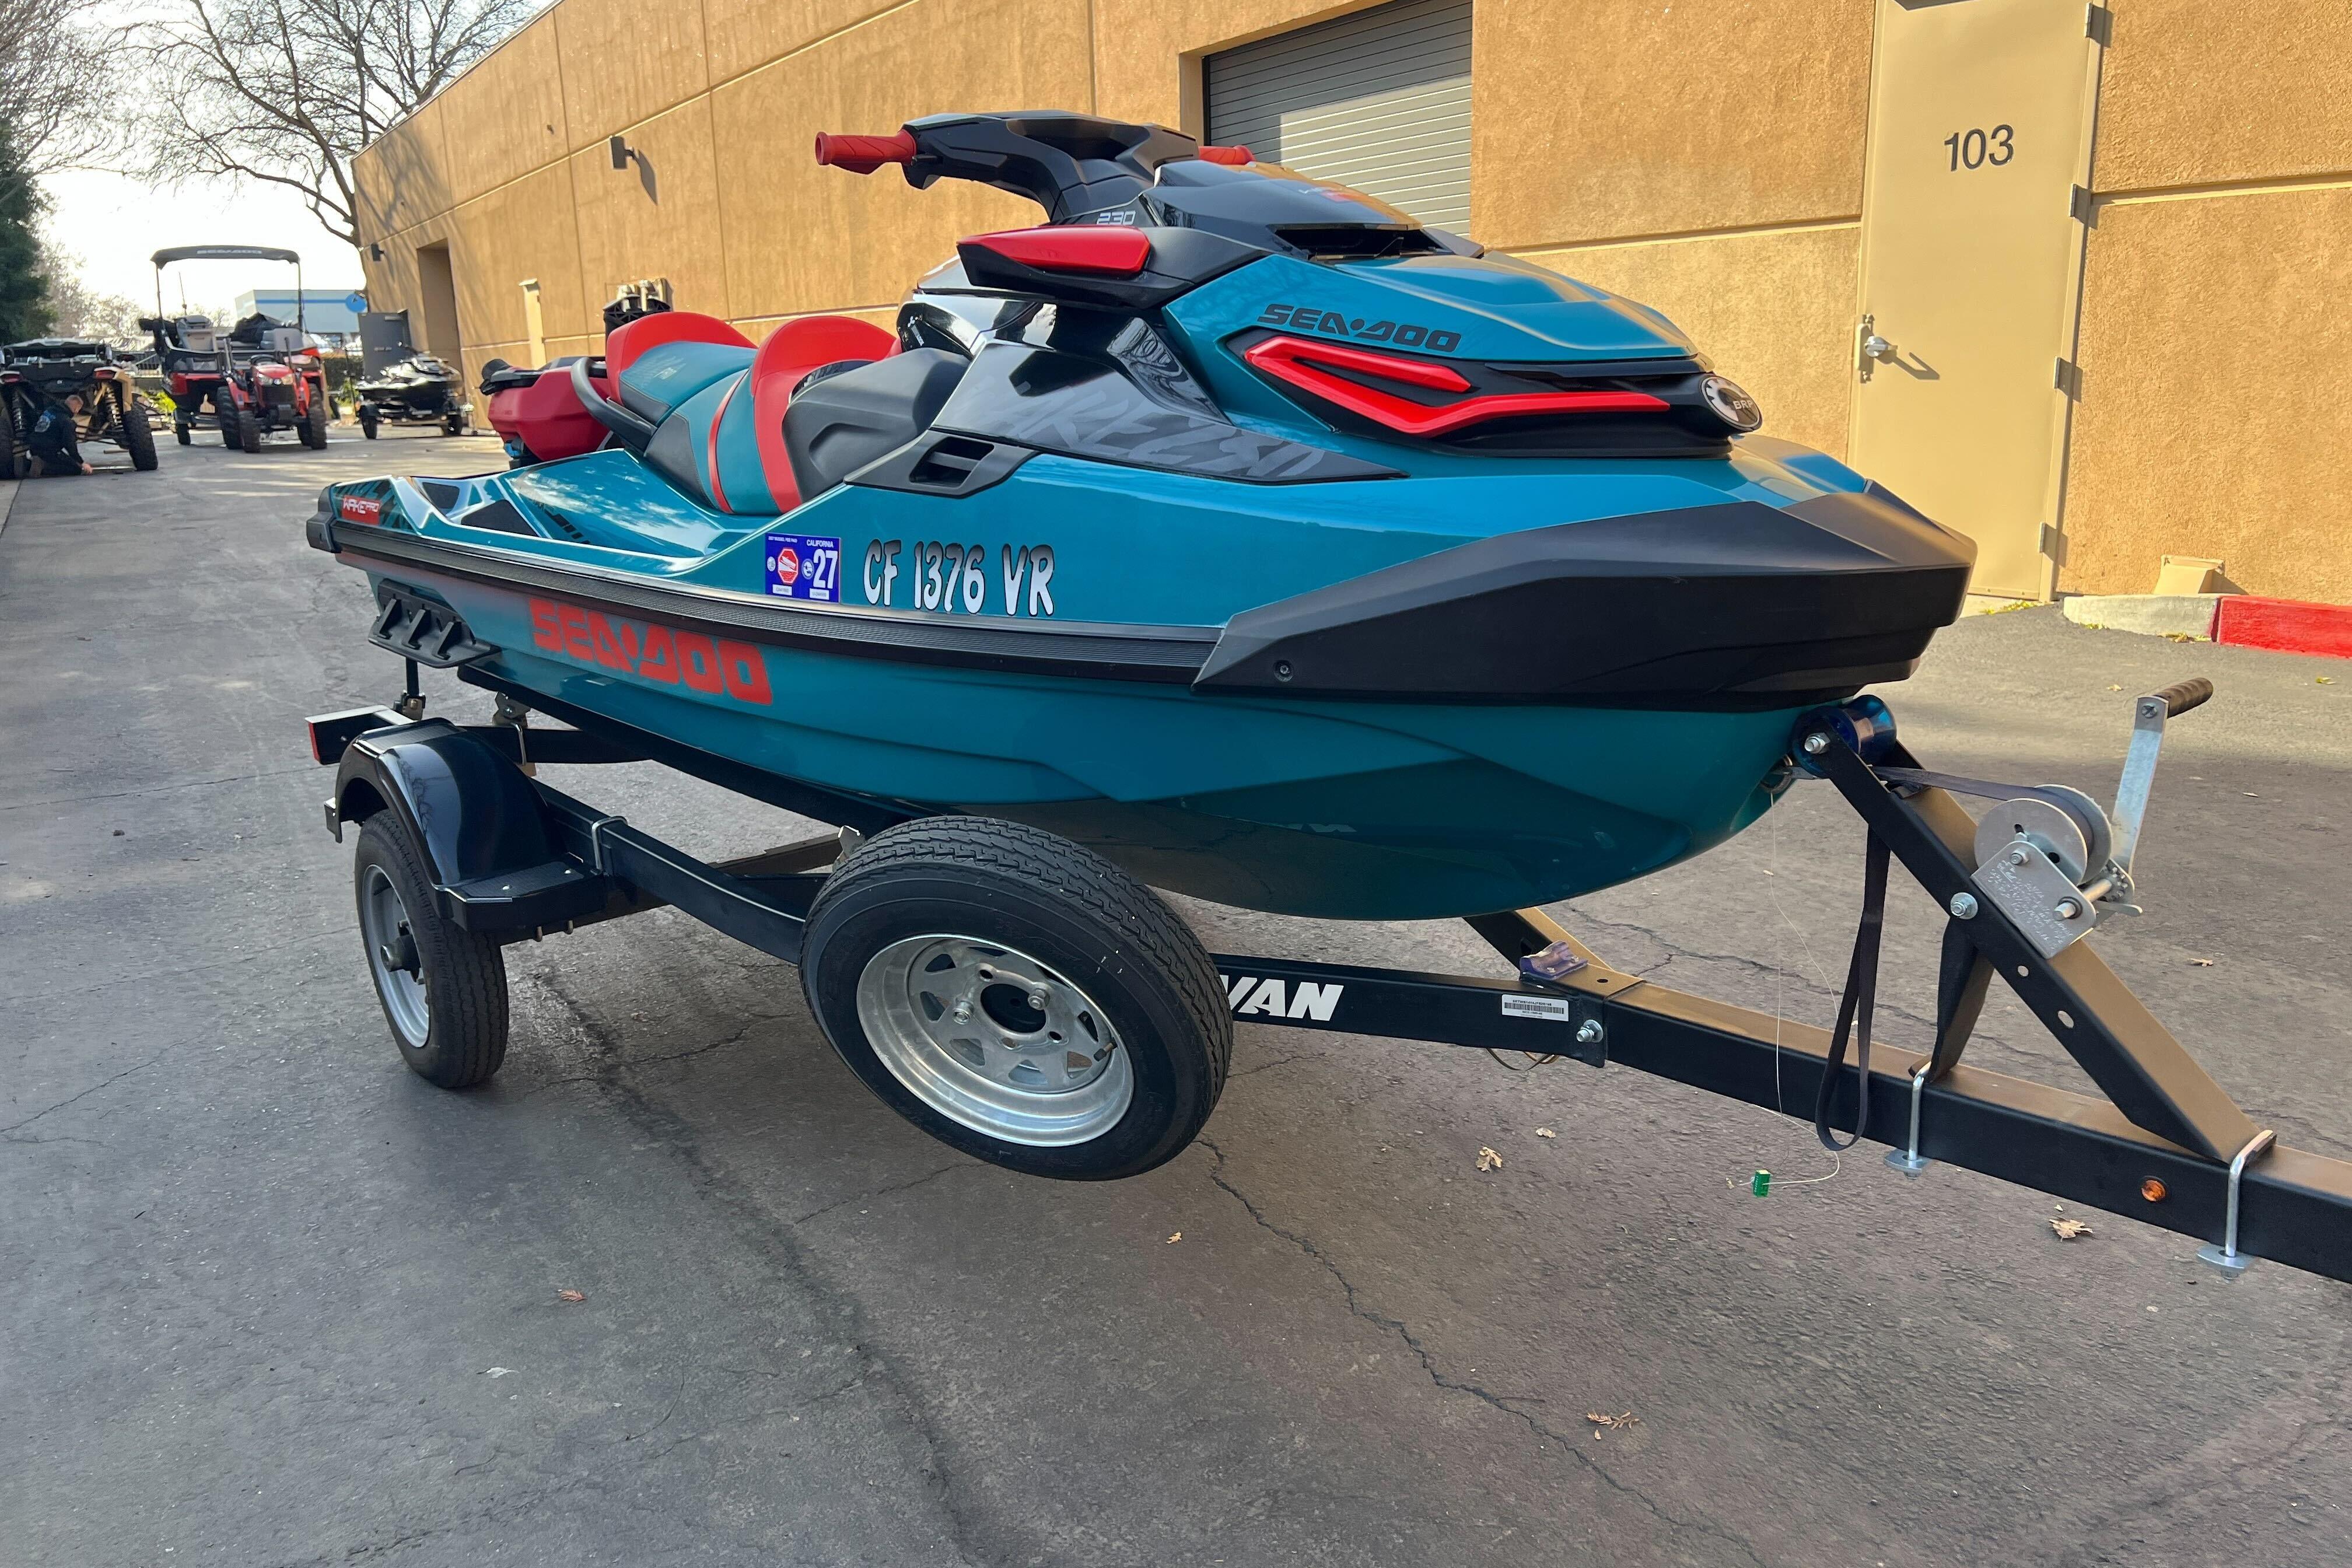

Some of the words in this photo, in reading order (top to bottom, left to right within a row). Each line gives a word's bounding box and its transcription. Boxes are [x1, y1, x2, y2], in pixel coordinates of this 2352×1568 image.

[1944, 124, 2014, 172] 103
[1096, 210, 1136, 225] 230
[1732, 400, 1753, 410] BRP
[806, 539, 834, 548] CALIFORNIA
[813, 548, 838, 589] 27
[863, 538, 902, 607] CF
[914, 540, 986, 614] 1376
[1002, 543, 1055, 617] VR
